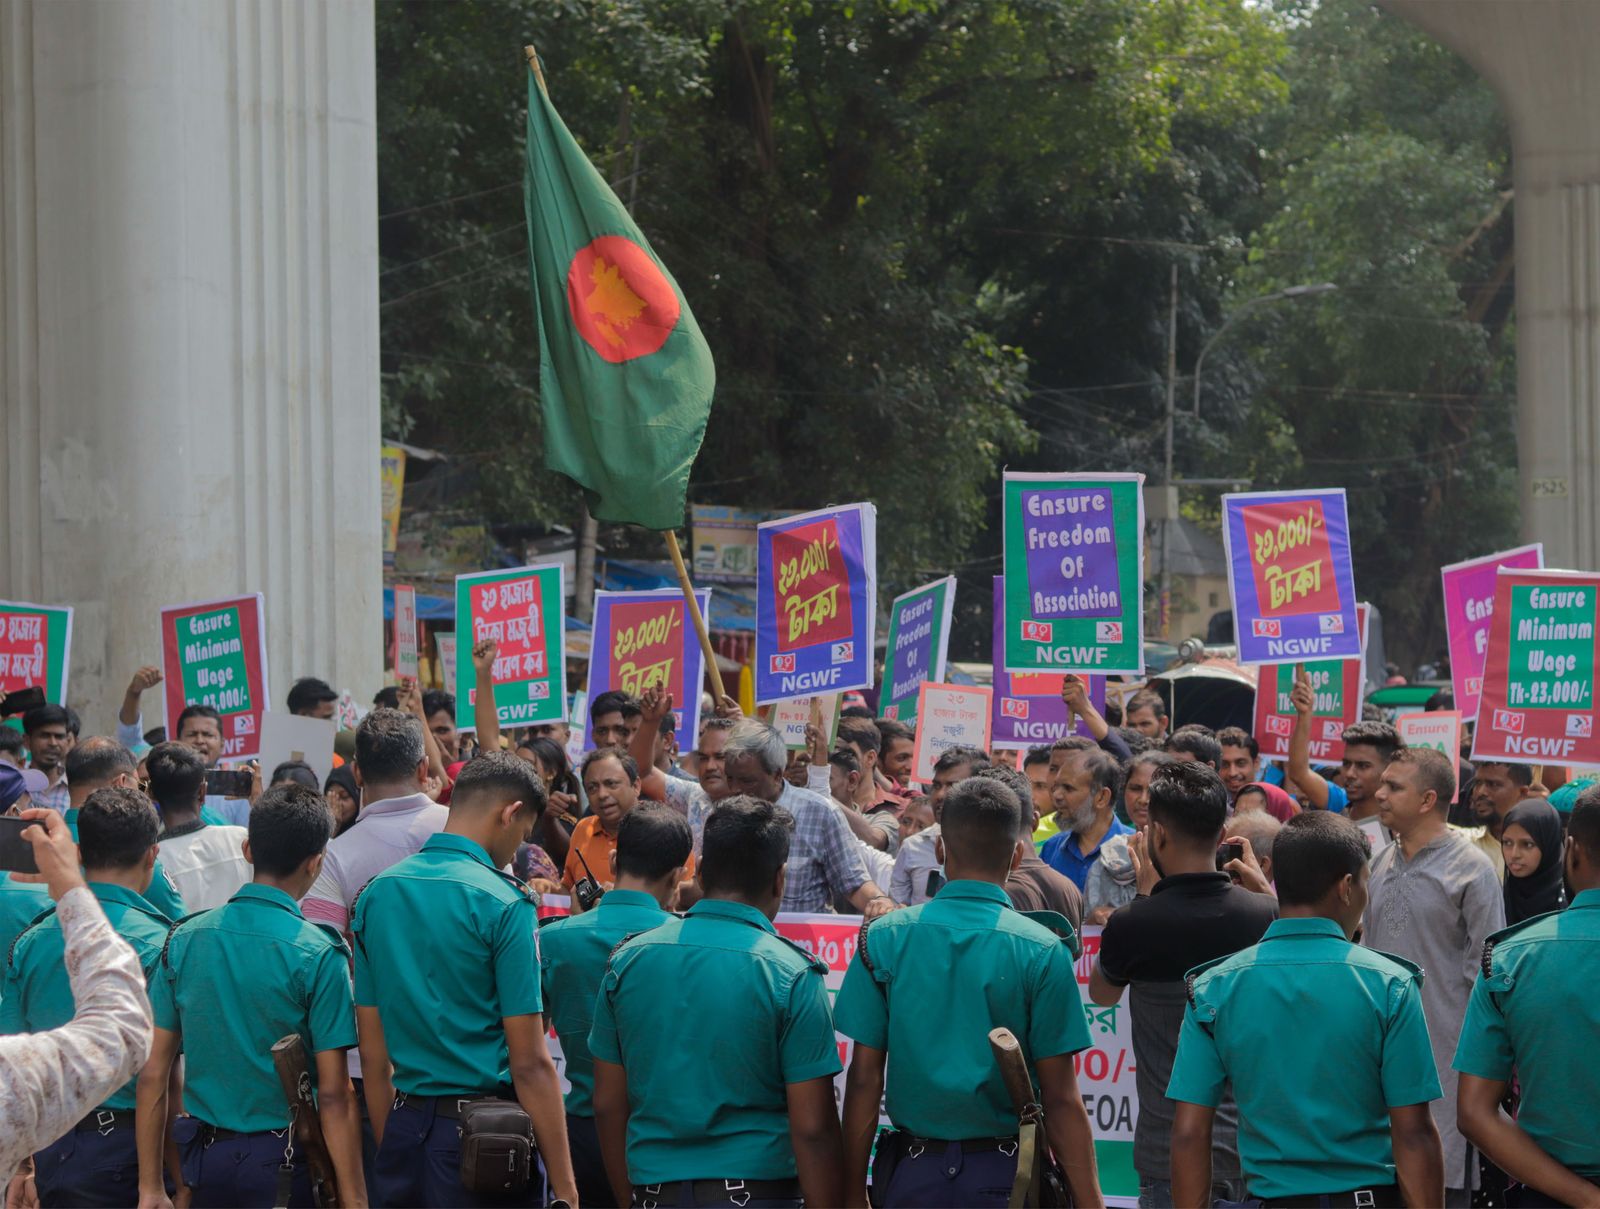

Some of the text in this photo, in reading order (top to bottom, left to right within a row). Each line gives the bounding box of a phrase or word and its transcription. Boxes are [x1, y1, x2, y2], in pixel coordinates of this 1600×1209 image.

[1028, 494, 1106, 517] Ensure
[1029, 523, 1111, 550] Freedom
[1255, 507, 1322, 566] ২৩,০০০/-
[778, 528, 836, 596] ২৩,০০০/-
[1060, 555, 1084, 579] Of
[1264, 559, 1323, 610] টাকা
[481, 588, 497, 612] ২৩
[1034, 585, 1118, 614] Association
[1465, 596, 1495, 622] Ens
[1530, 587, 1586, 610] Ensure
[189, 612, 232, 636] Ensure
[785, 584, 840, 643] টাকা
[900, 598, 933, 625] Ensure
[1517, 616, 1592, 642] Minimum
[185, 638, 241, 665] Minimum
[1036, 646, 1108, 664] NGWF
[1268, 637, 1332, 656] NGWF
[1527, 650, 1577, 677] Wage
[197, 666, 233, 689] Wage
[781, 667, 841, 693] NGWF
[1510, 680, 1589, 705] Tk-23,000/-
[497, 703, 538, 720] GWF
[1275, 737, 1331, 756] NWF
[1504, 735, 1576, 757] NGWF
